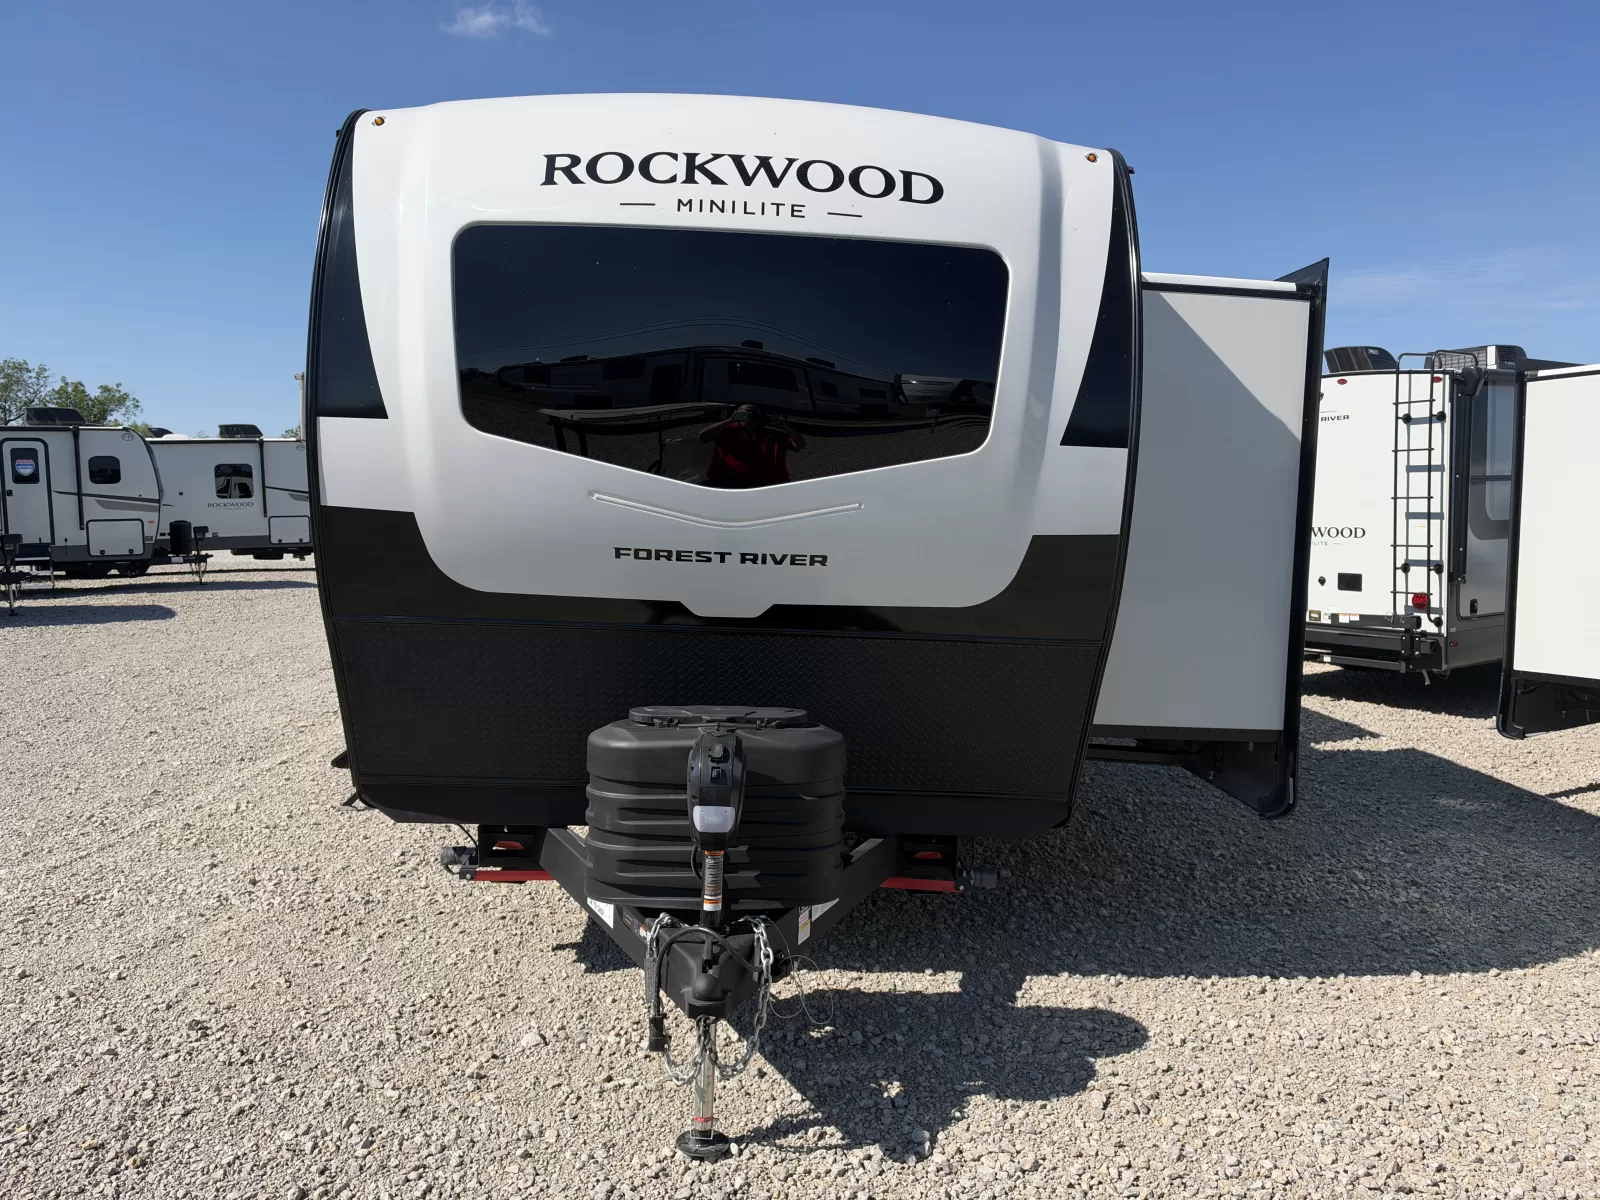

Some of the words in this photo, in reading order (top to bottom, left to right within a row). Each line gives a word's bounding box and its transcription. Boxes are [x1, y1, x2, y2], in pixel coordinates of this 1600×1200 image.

[540, 151, 944, 205] ROCKWOOD
[676, 198, 806, 218] MINILITE
[1320, 414, 1350, 422] RIVER
[1312, 526, 1366, 539] WOOD
[613, 547, 733, 564] FOREST
[739, 552, 828, 567] RIVER
